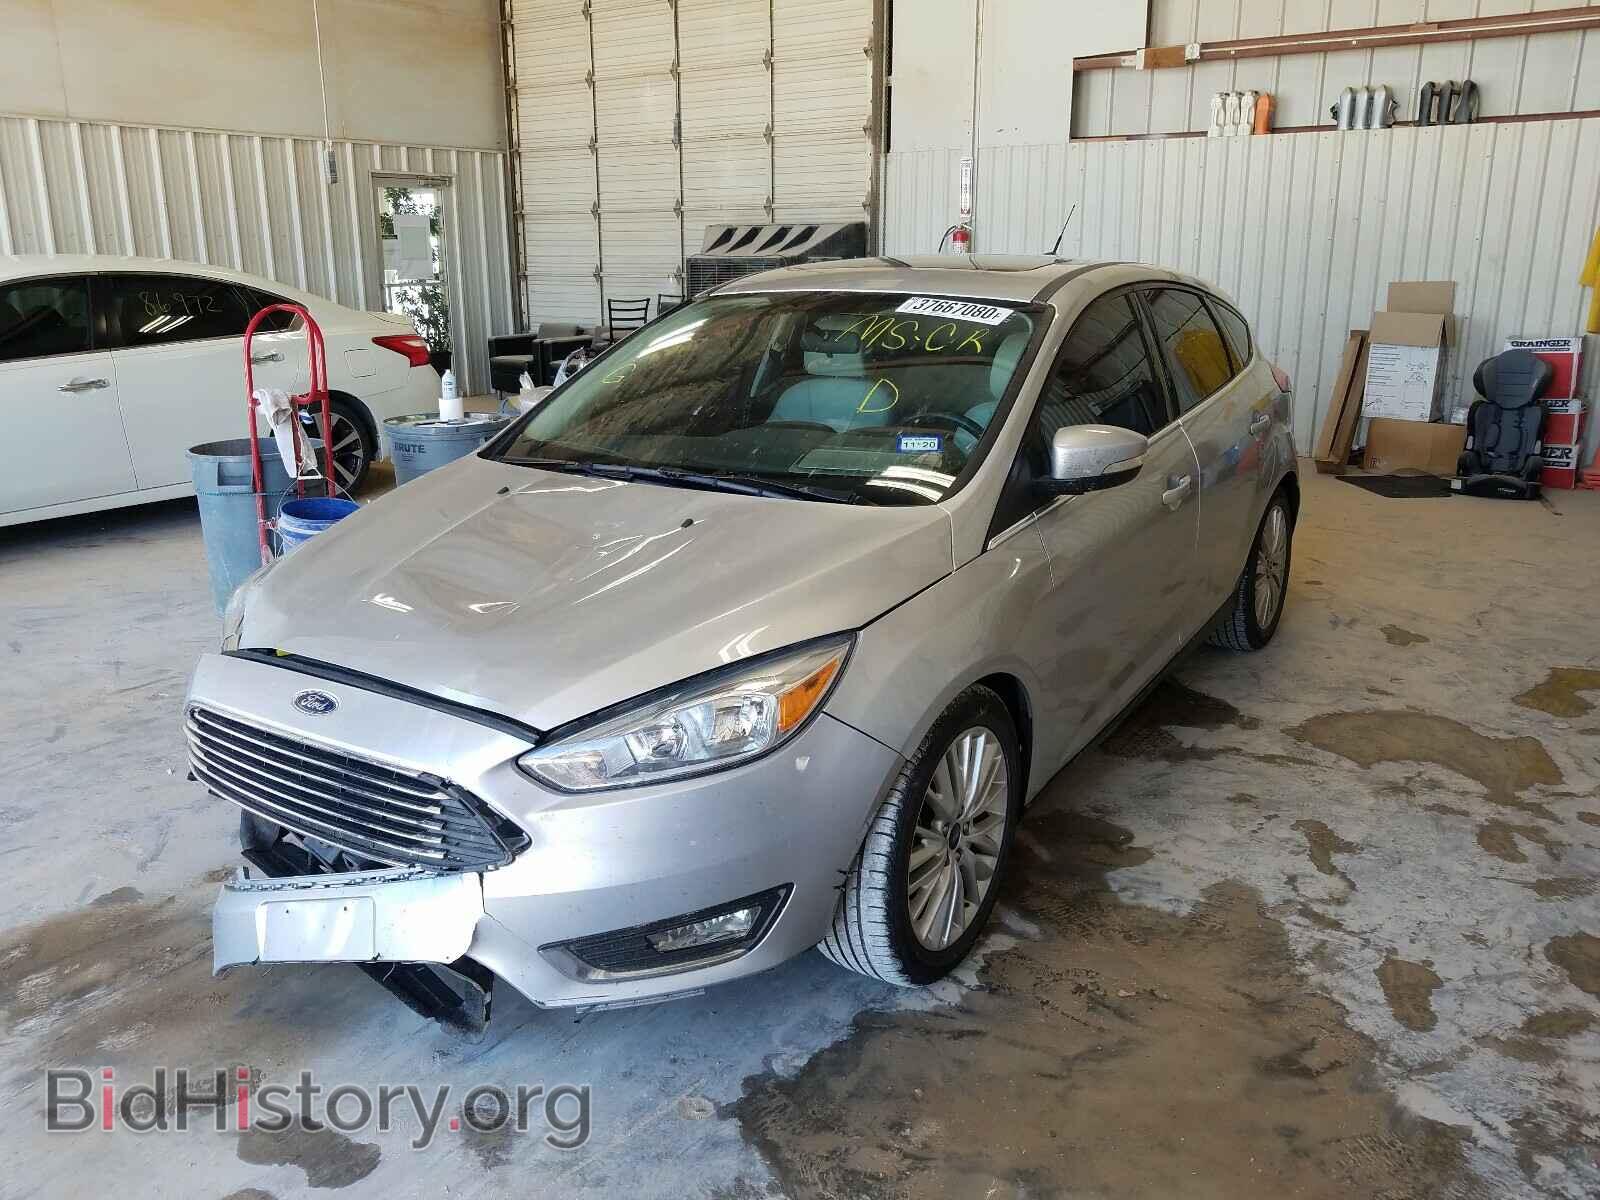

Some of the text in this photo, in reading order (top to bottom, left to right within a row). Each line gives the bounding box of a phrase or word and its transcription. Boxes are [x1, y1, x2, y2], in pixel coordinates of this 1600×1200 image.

[856, 378, 899, 413] D
[394, 441, 426, 454] BRUTE
[301, 694, 330, 711] Ford
